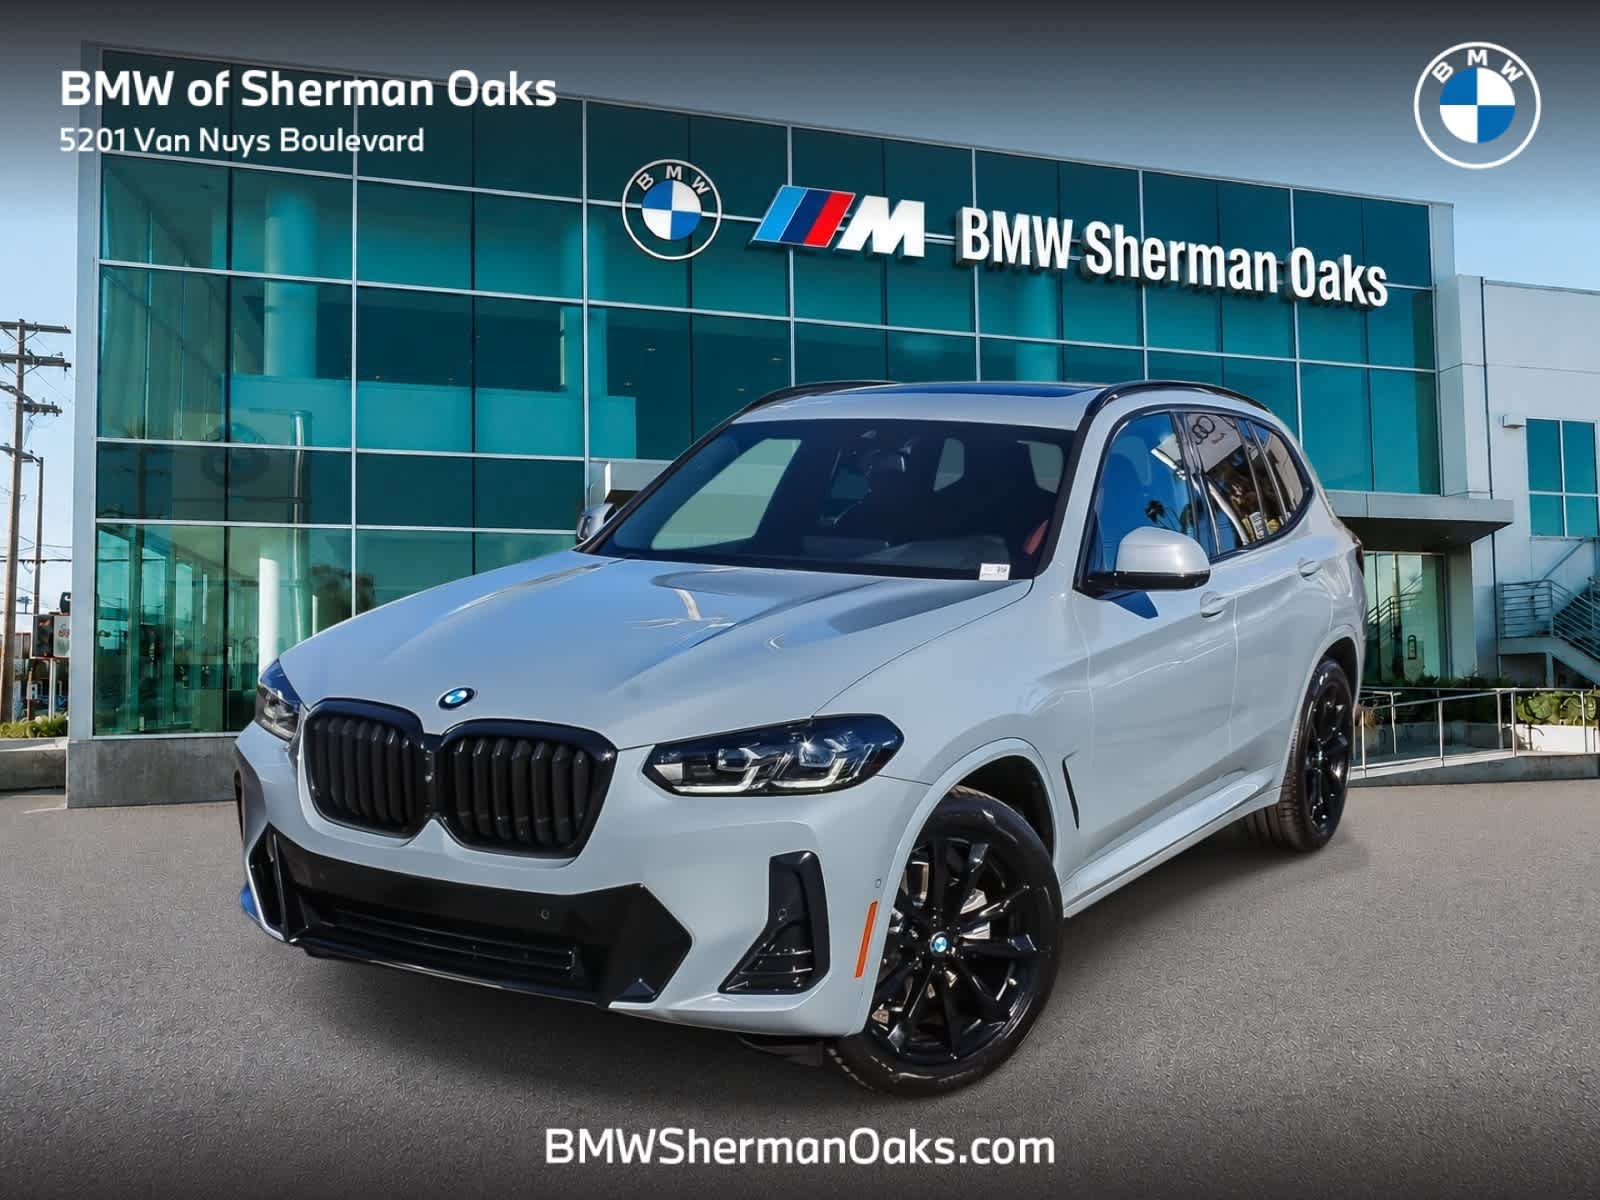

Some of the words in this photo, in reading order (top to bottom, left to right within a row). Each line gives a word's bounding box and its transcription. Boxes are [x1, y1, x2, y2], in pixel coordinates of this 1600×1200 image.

[636, 165, 711, 195] BMW
[835, 195, 925, 257] M
[959, 206, 1074, 270] BMW
[1084, 220, 1278, 294] Sherman
[1290, 246, 1388, 308] Oaks
